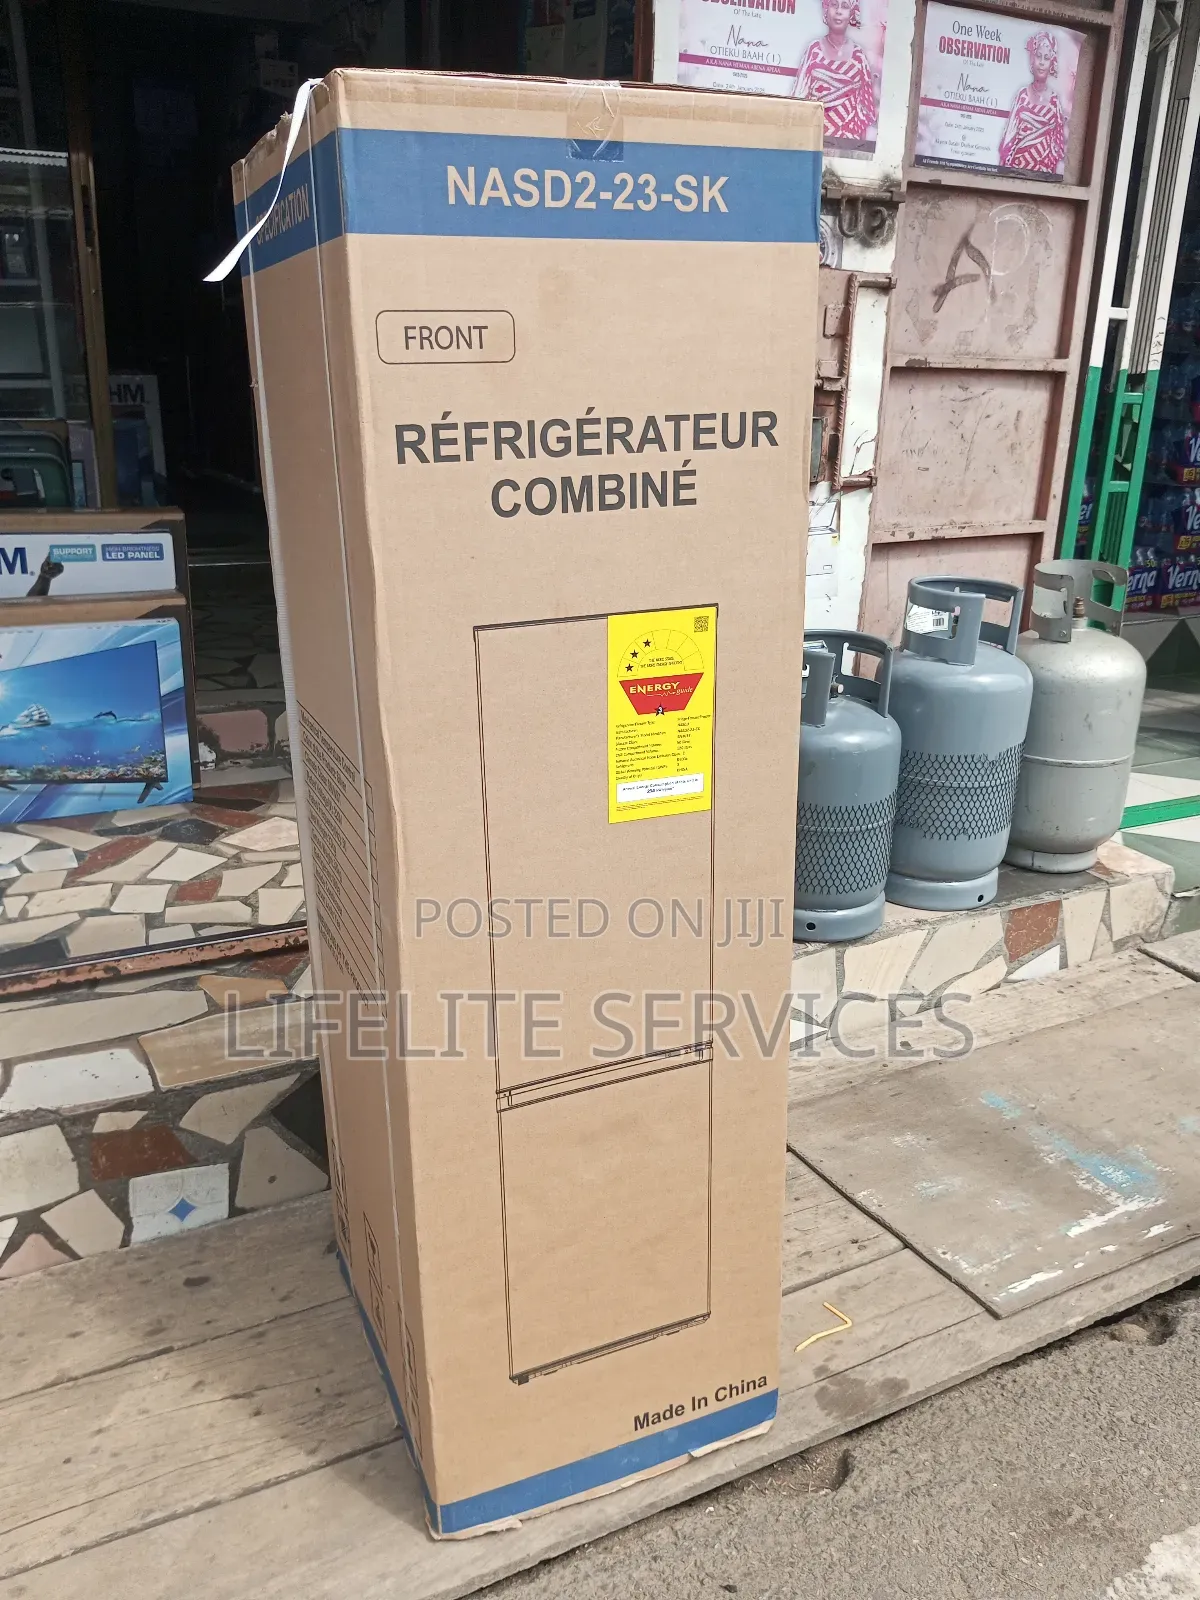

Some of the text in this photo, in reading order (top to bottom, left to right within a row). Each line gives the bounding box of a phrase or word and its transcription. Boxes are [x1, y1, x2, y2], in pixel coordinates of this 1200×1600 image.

[726, 24, 768, 47] Nana
[952, 20, 1002, 42] One Week
[742, 50, 764, 62] BAAH
[938, 36, 1010, 64] OBSERVATION
[446, 166, 730, 213] NASD2-23-SK
[404, 325, 488, 350] FRONT
[394, 406, 779, 465] RÉFRIGÉRATEUR
[490, 460, 698, 518] COMBINÉ
[53, 548, 93, 556] SUPPORT
[630, 682, 693, 696] ENERGY guide
[634, 1375, 768, 1431] Made In China
